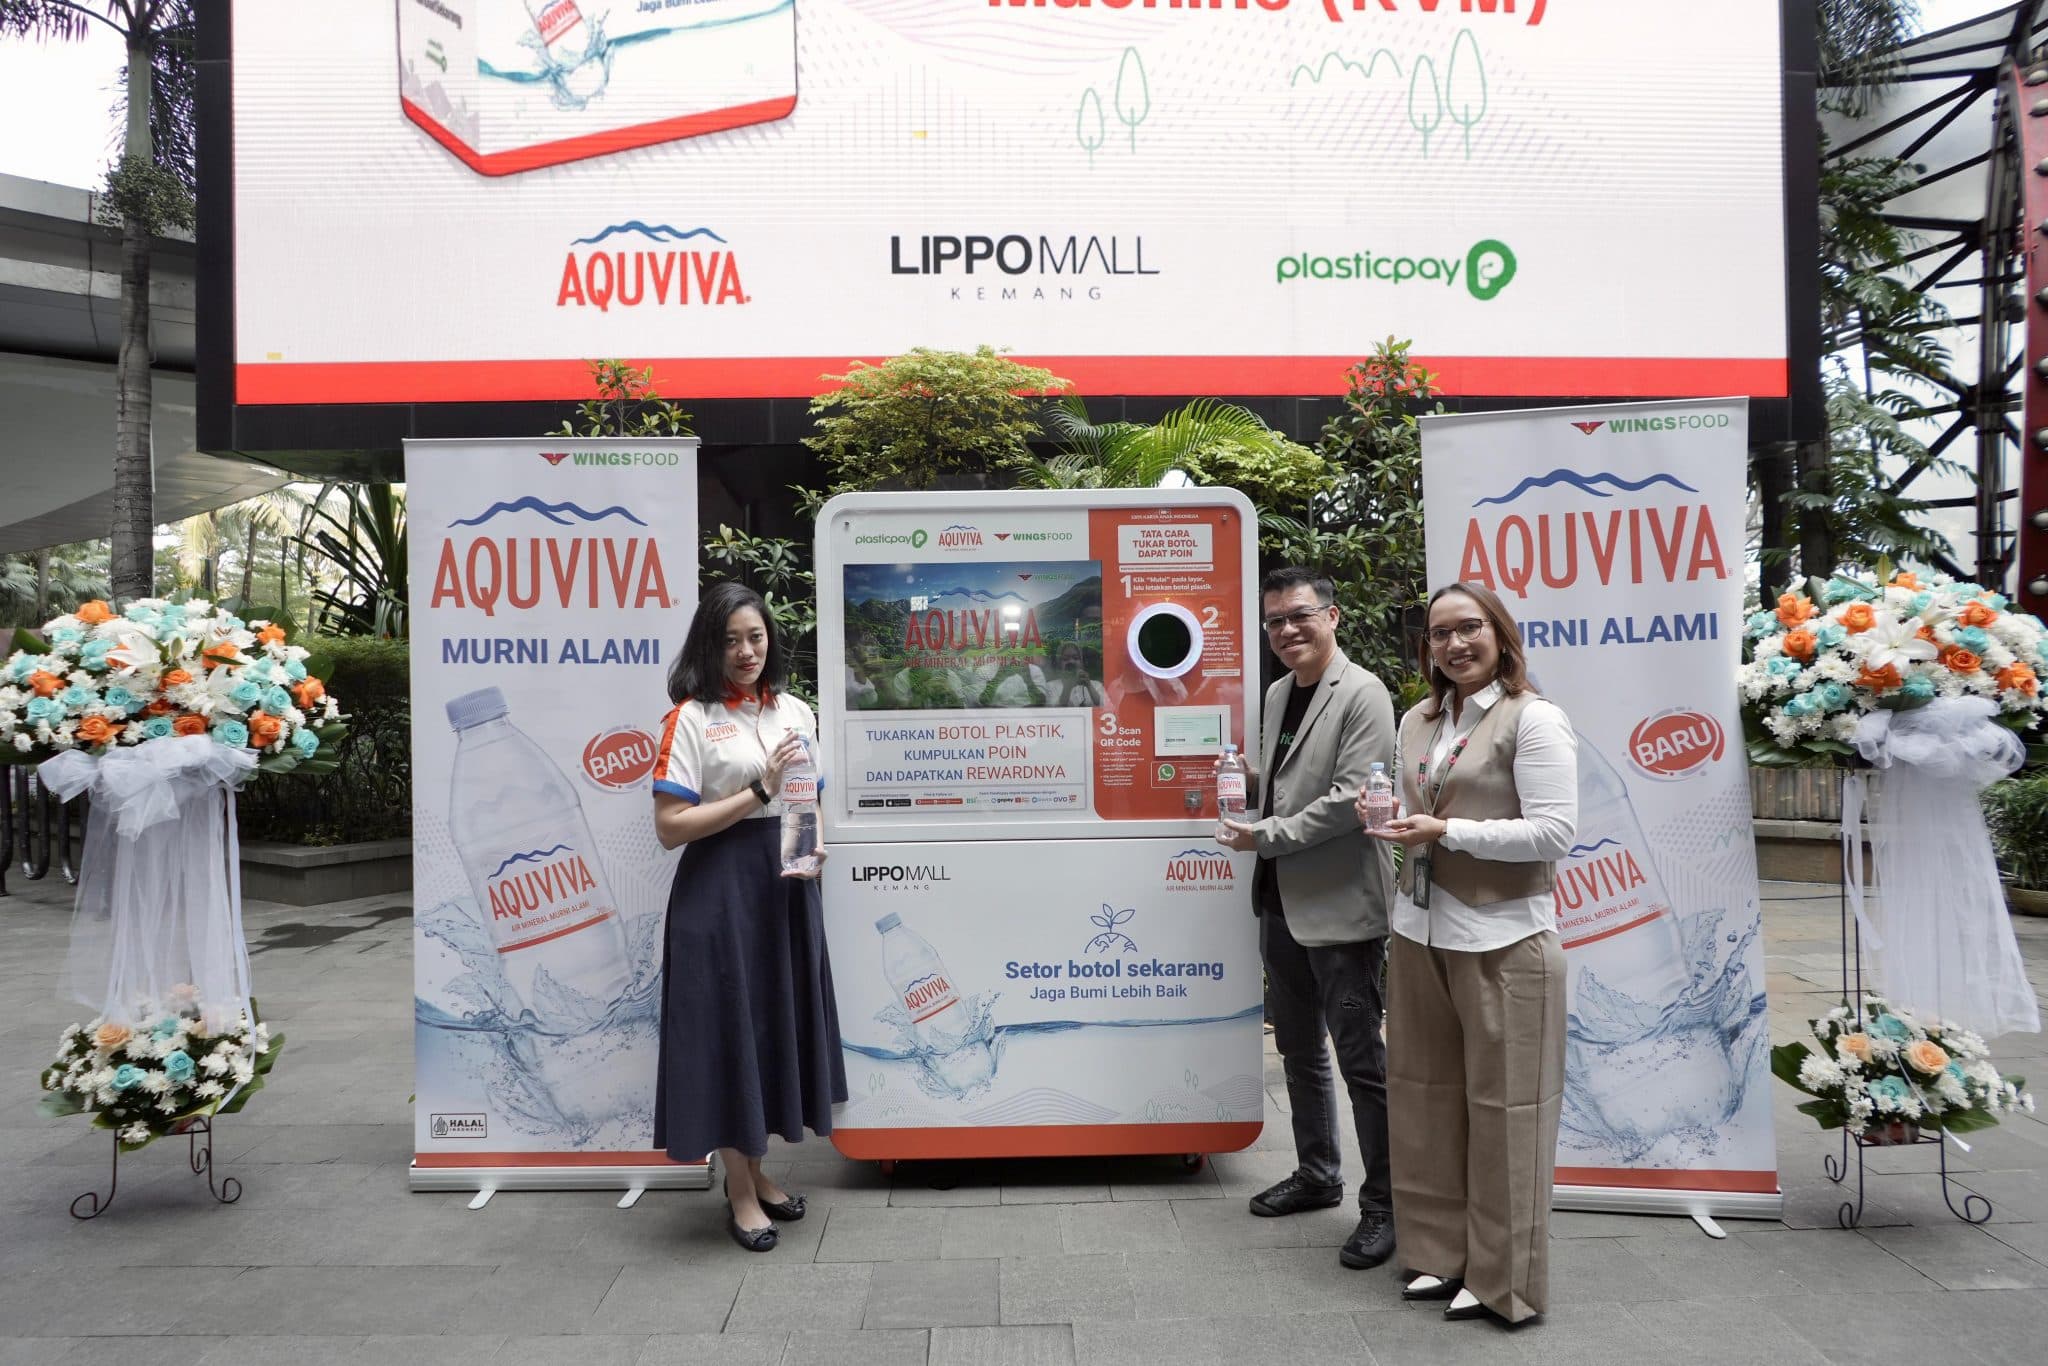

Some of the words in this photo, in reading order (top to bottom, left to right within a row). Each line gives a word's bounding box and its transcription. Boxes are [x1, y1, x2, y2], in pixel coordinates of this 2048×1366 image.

[1276, 251, 1461, 287] plasticpay
[556, 251, 748, 312] AQUVIVA
[951, 287, 1102, 301] KEMANG
[1608, 414, 1729, 434] WINGSFOOD
[573, 452, 679, 466] WINGSFOOD
[855, 534, 911, 546] plasticpay
[938, 532, 983, 547] AQUVIVA
[1012, 532, 1073, 541] WINGSFOOD
[1132, 540, 1165, 548] TUKAR
[1167, 539, 1198, 548] BOTOL
[1141, 530, 1162, 538] TATA
[1164, 530, 1190, 538] CARA
[1138, 550, 1167, 558] DAPAT
[1170, 549, 1193, 558] POIN
[1458, 504, 1727, 599] AQUVIVA
[430, 537, 672, 617] AQUVIVA
[1120, 574, 1132, 598] 1
[1190, 583, 1212, 591] plastik
[1202, 606, 1219, 628] 2
[1517, 619, 1588, 648] RNI
[1599, 612, 1719, 646] ALAMI
[442, 638, 548, 664] MURNI
[558, 638, 660, 665] ALAMI
[866, 729, 935, 741] TUKARKAN
[938, 726, 990, 740] BOTOL
[995, 725, 1065, 740] PLASTIK,
[1100, 713, 1117, 735] 3
[1118, 727, 1142, 735] Scan
[1100, 738, 1114, 747] QR
[1116, 738, 1142, 747] Code
[1636, 721, 1712, 767] BARU
[588, 739, 653, 780] BARU
[904, 748, 984, 761] KUMPULKAN
[988, 746, 1027, 759] POIN
[866, 770, 893, 782] DAN
[896, 769, 963, 782] DAPATKAN
[967, 765, 1066, 781] REWARDNYA
[1166, 860, 1233, 883] AQUVIVA
[488, 855, 597, 921] AQUVIVA
[1552, 849, 1647, 918] UVIVA
[521, 914, 549, 929] MINERAL
[1561, 915, 1595, 930] MINERAL
[1594, 906, 1618, 920] MURNI
[1619, 898, 1640, 911] ALAMI
[1005, 961, 1062, 979] Setor
[1068, 959, 1121, 978] botol
[1127, 958, 1224, 981] sekarang
[904, 977, 950, 1011] AQUVIVA
[1030, 986, 1066, 1002] Jaga
[1070, 985, 1108, 999] Bumi
[1112, 984, 1151, 998] Lebih
[1156, 983, 1188, 998] Baik
[450, 1119, 484, 1127] HALAL
